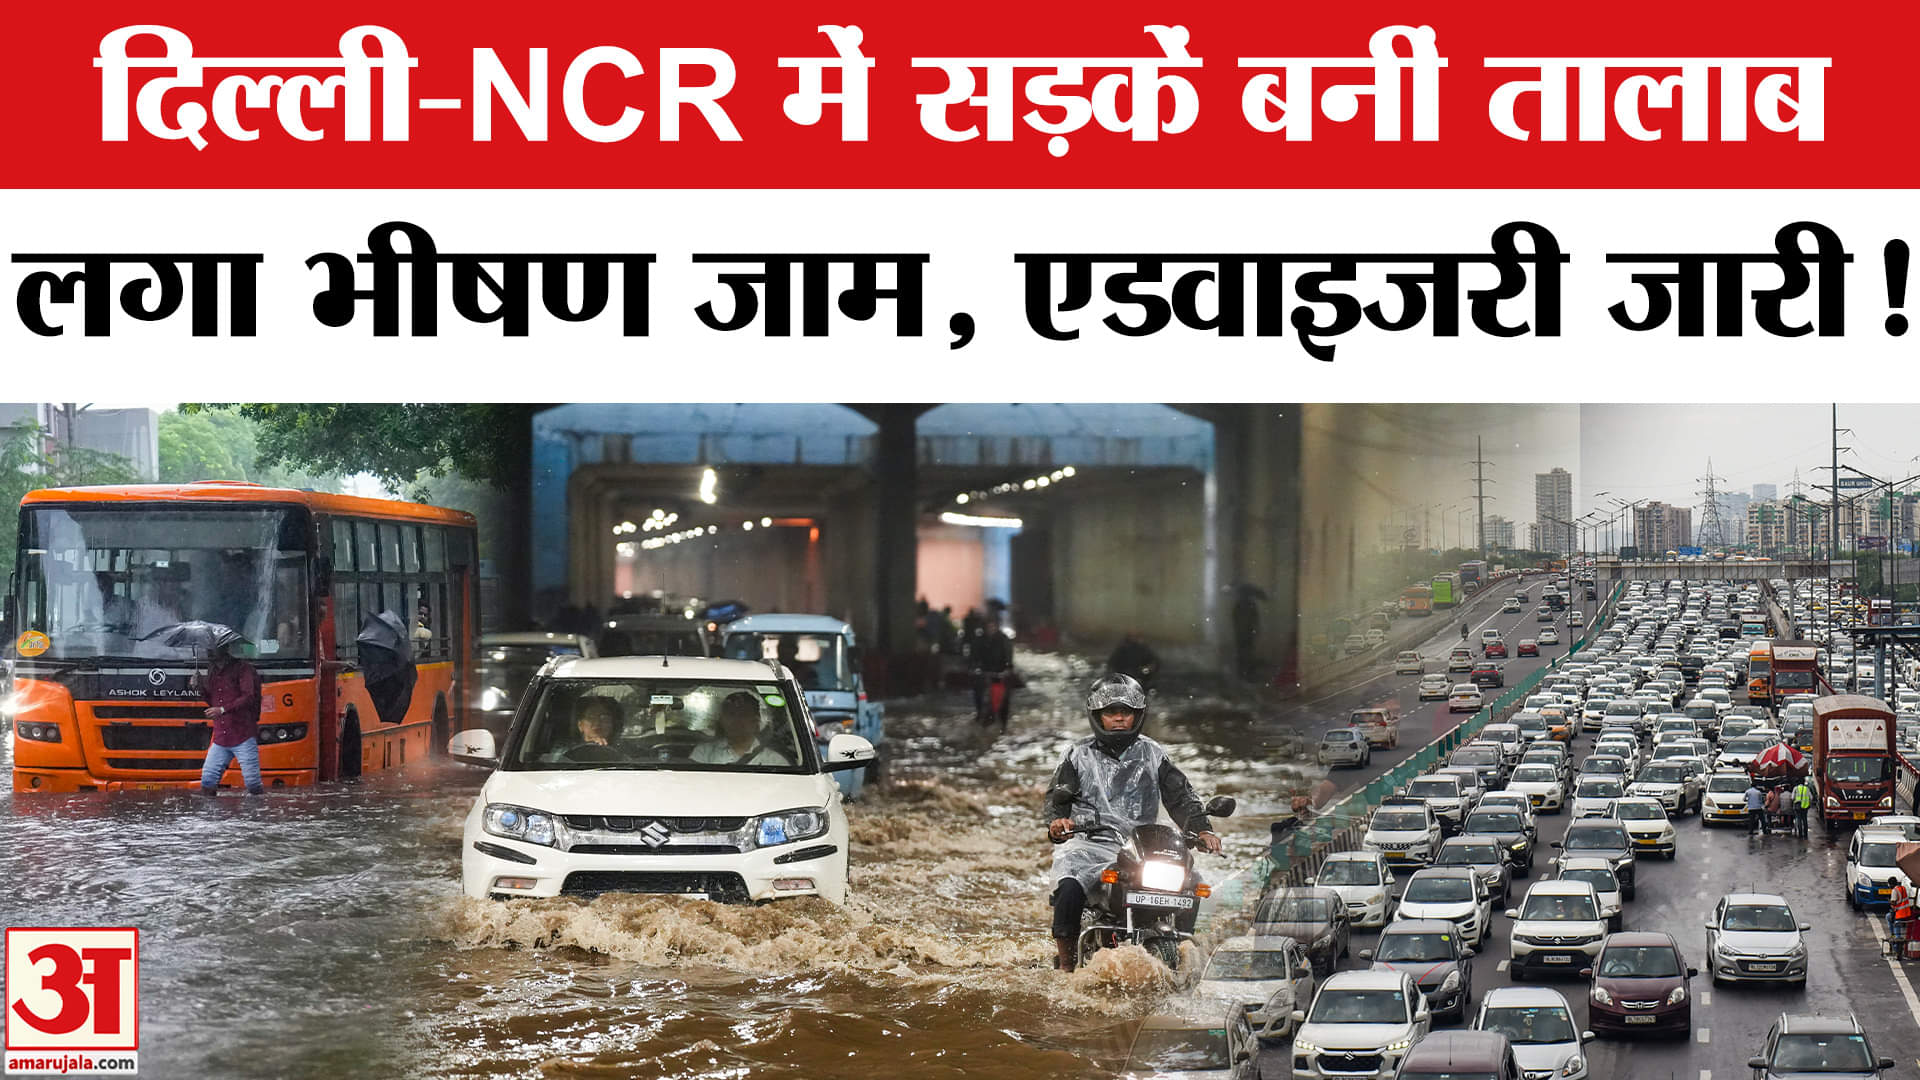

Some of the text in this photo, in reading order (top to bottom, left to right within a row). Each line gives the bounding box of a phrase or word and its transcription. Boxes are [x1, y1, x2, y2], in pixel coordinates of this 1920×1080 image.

[108, 688, 147, 696] ASHOK
[282, 693, 294, 707] G
[1135, 895, 1146, 904] UP
